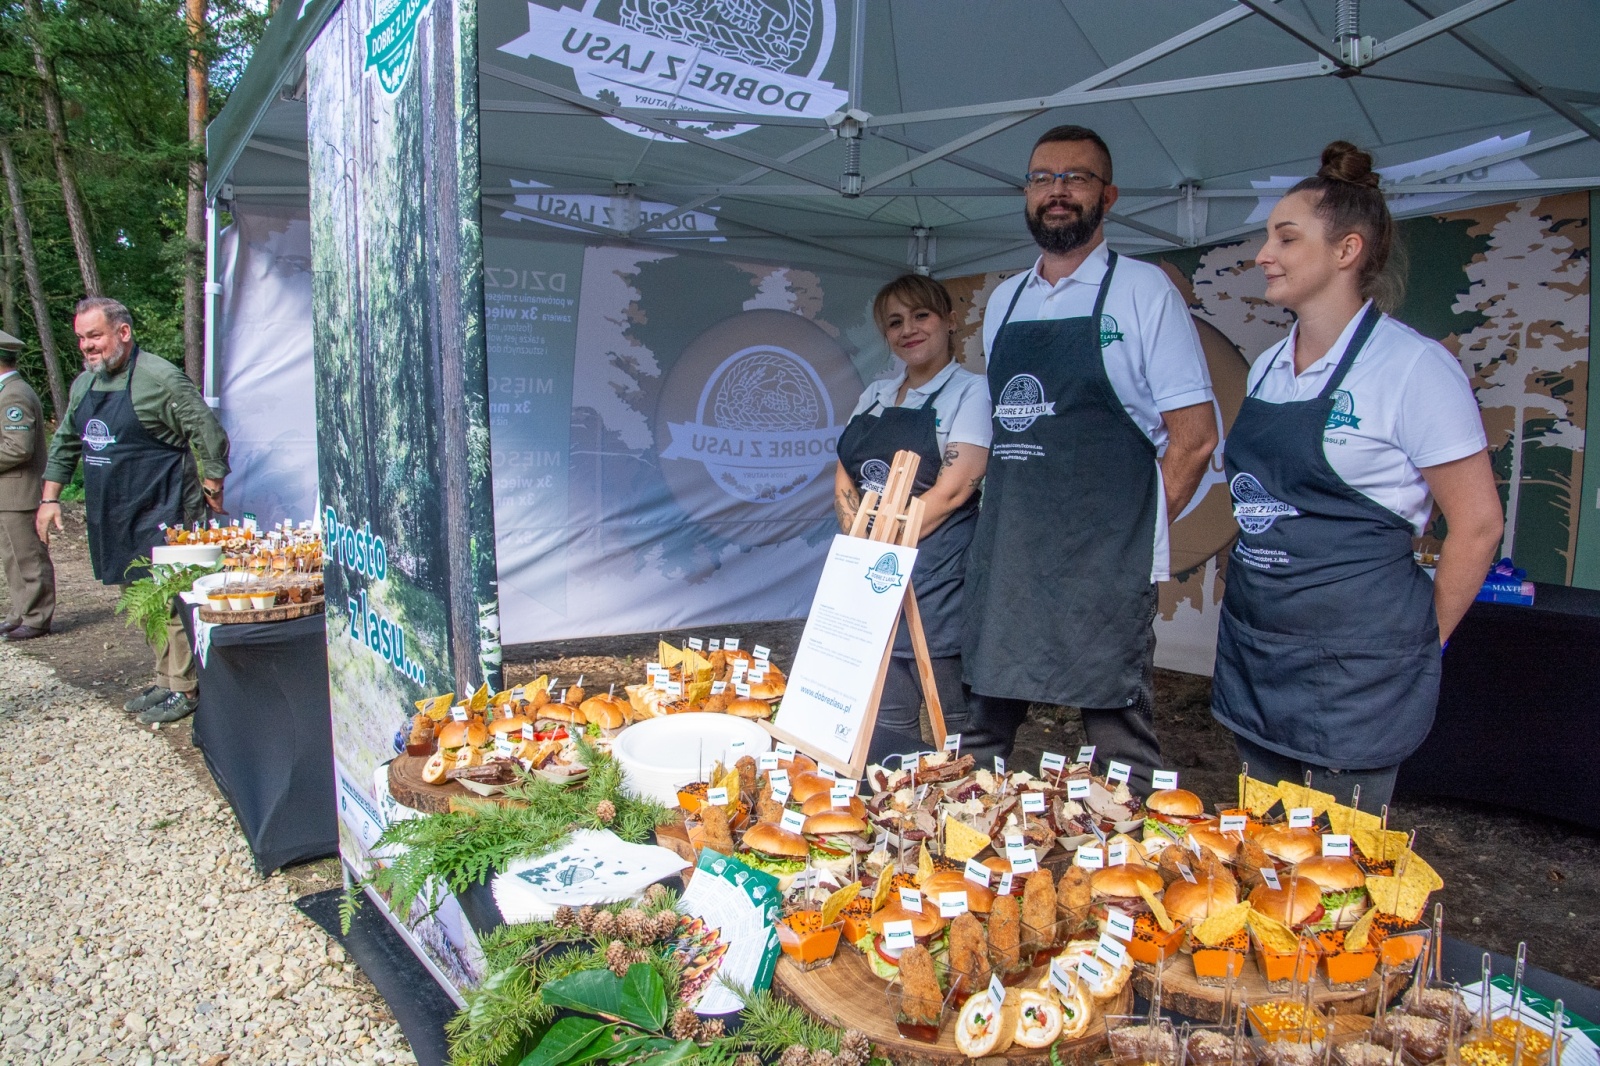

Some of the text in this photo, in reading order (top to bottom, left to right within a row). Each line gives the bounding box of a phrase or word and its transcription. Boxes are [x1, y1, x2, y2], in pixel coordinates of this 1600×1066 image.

[372, 21, 395, 57] DOBRE
[395, 14, 401, 37] Z
[1025, 405, 1047, 414] LASU
[1331, 413, 1352, 424] LASU
[1258, 505, 1265, 513] Z
[1266, 504, 1290, 513] LASU
[326, 505, 387, 582] Prosto
[348, 587, 426, 687] z lasu...
[800, 685, 852, 714] www.dobrezlasu.pl
